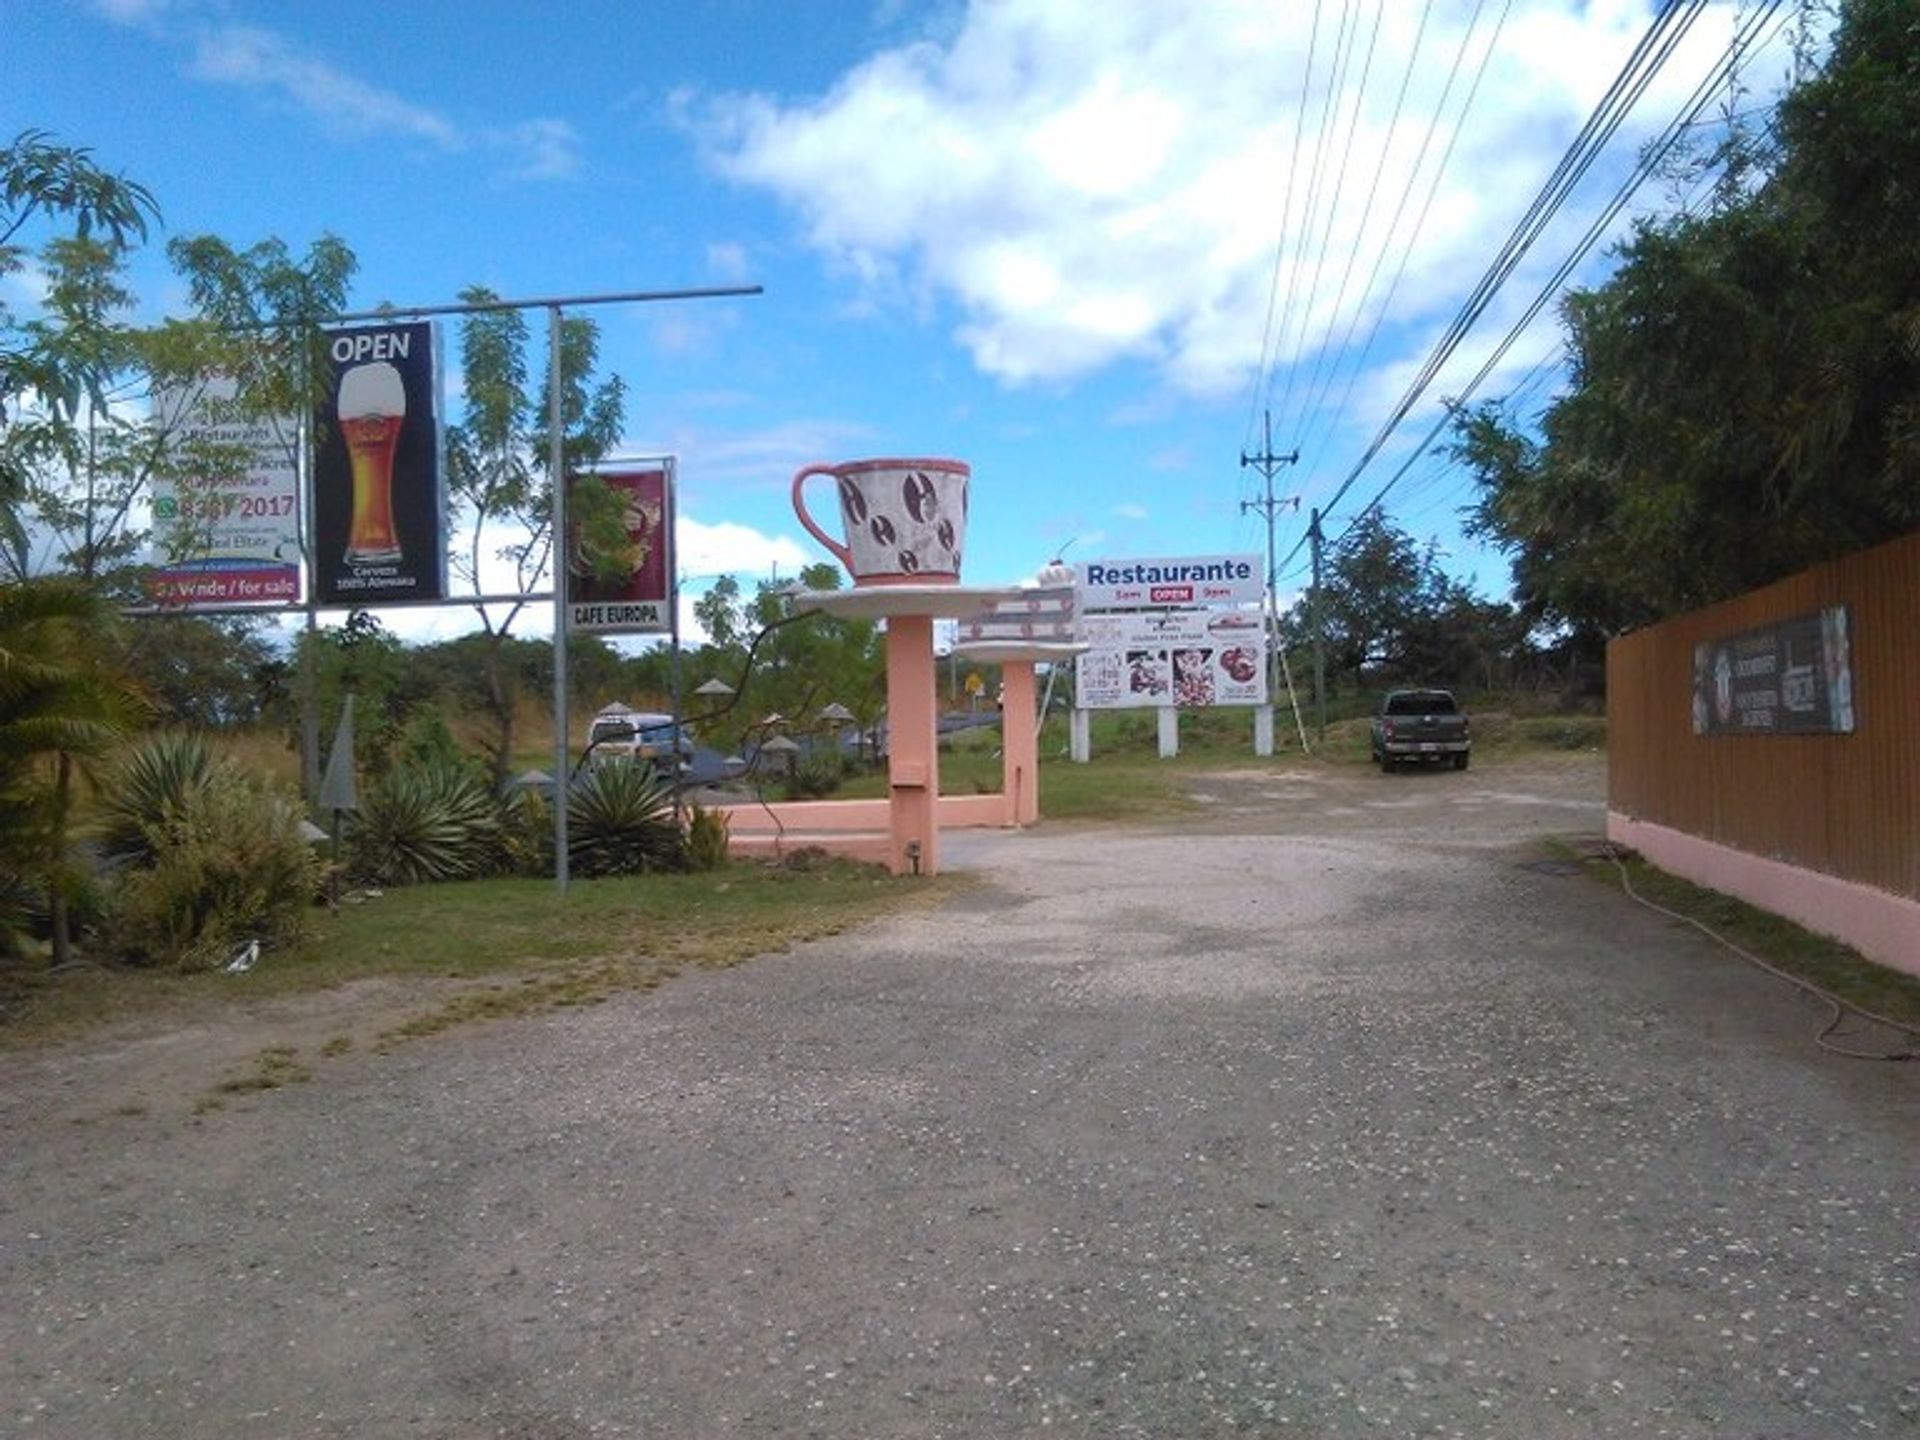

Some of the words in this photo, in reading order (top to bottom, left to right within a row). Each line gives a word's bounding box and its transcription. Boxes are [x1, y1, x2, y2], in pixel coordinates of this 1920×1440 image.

[332, 332, 411, 362] OPEN
[241, 495, 295, 517] 2017
[1087, 559, 1251, 585] Restaurante
[240, 579, 262, 595] for
[264, 577, 297, 594] sale
[1152, 589, 1190, 602] OPEN
[575, 607, 603, 625] CAFE
[607, 605, 659, 624] EUROPA
